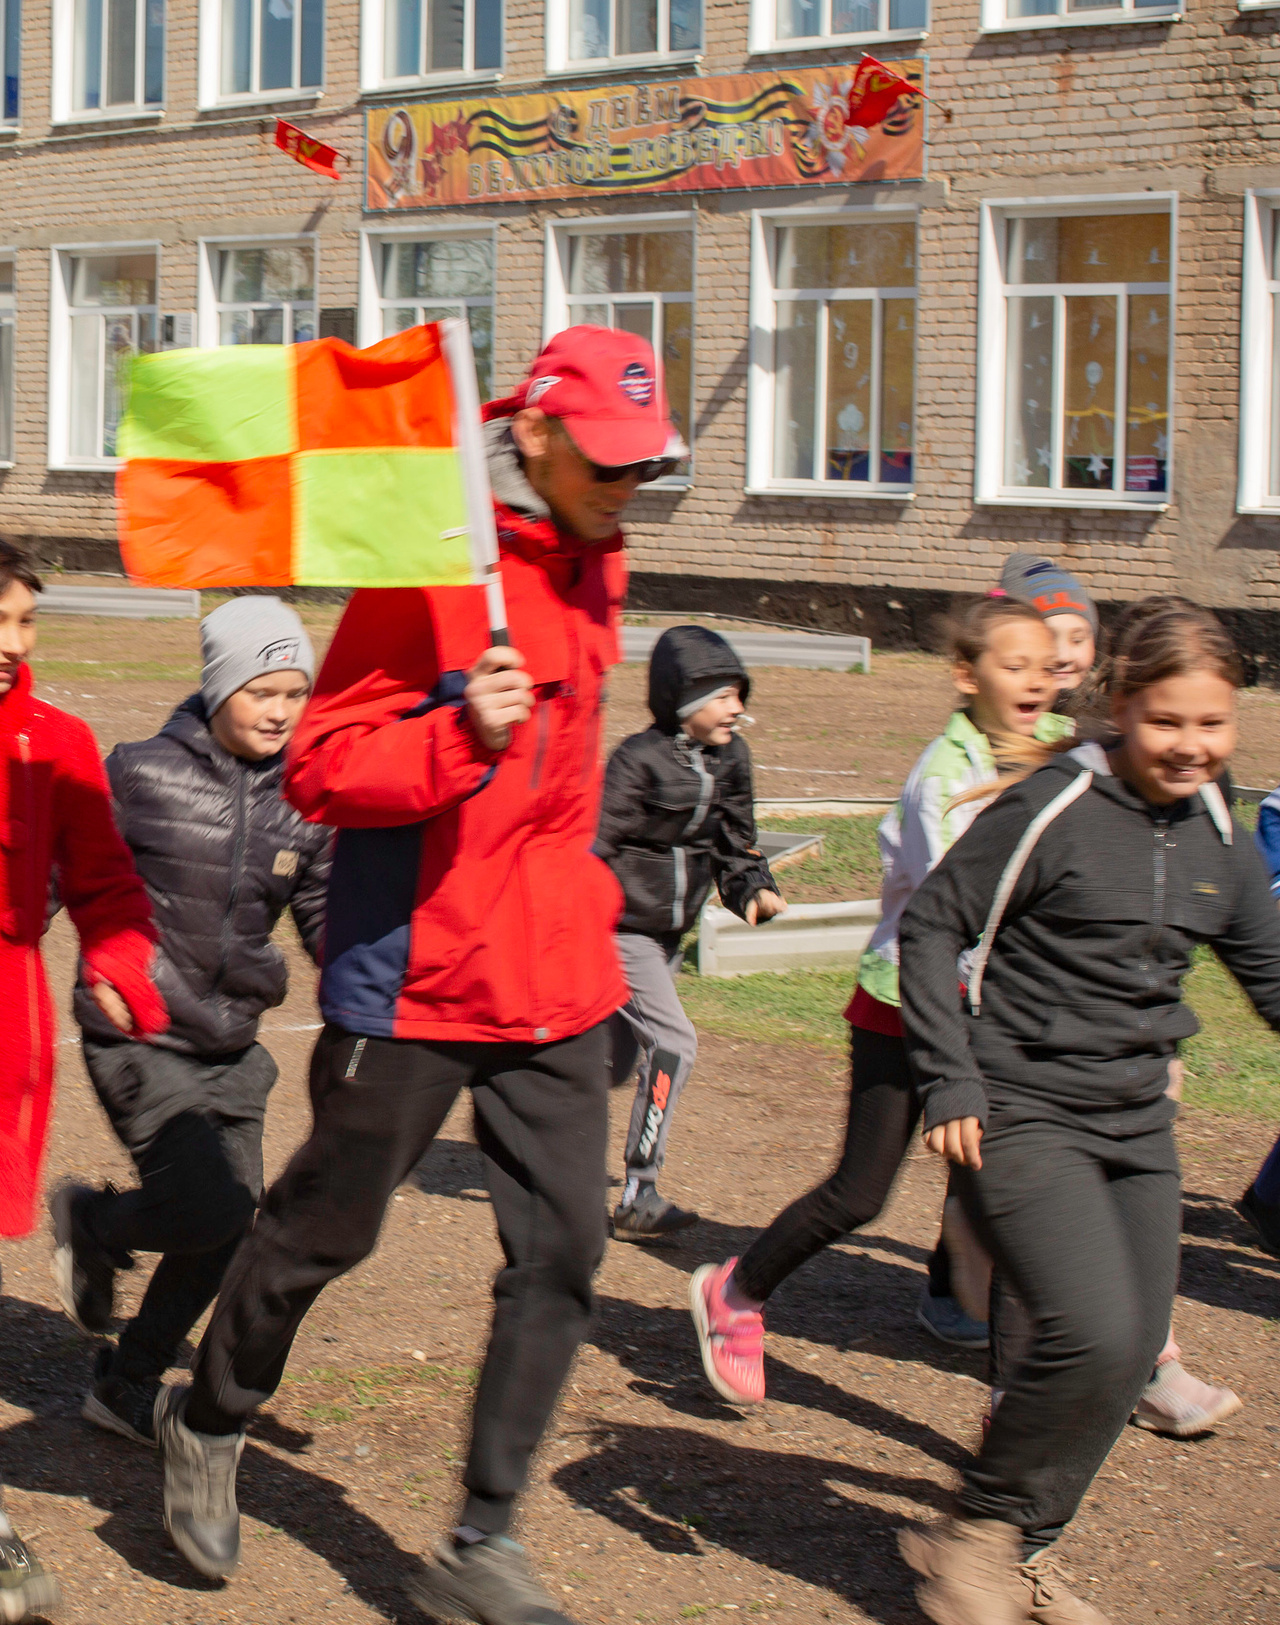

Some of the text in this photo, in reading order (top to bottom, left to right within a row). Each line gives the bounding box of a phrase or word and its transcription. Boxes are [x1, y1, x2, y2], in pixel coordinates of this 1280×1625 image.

[585, 85, 681, 141] ДНЁМ
[468, 118, 784, 198] ВЕЛИКОЙ ПОБЕДЫ!
